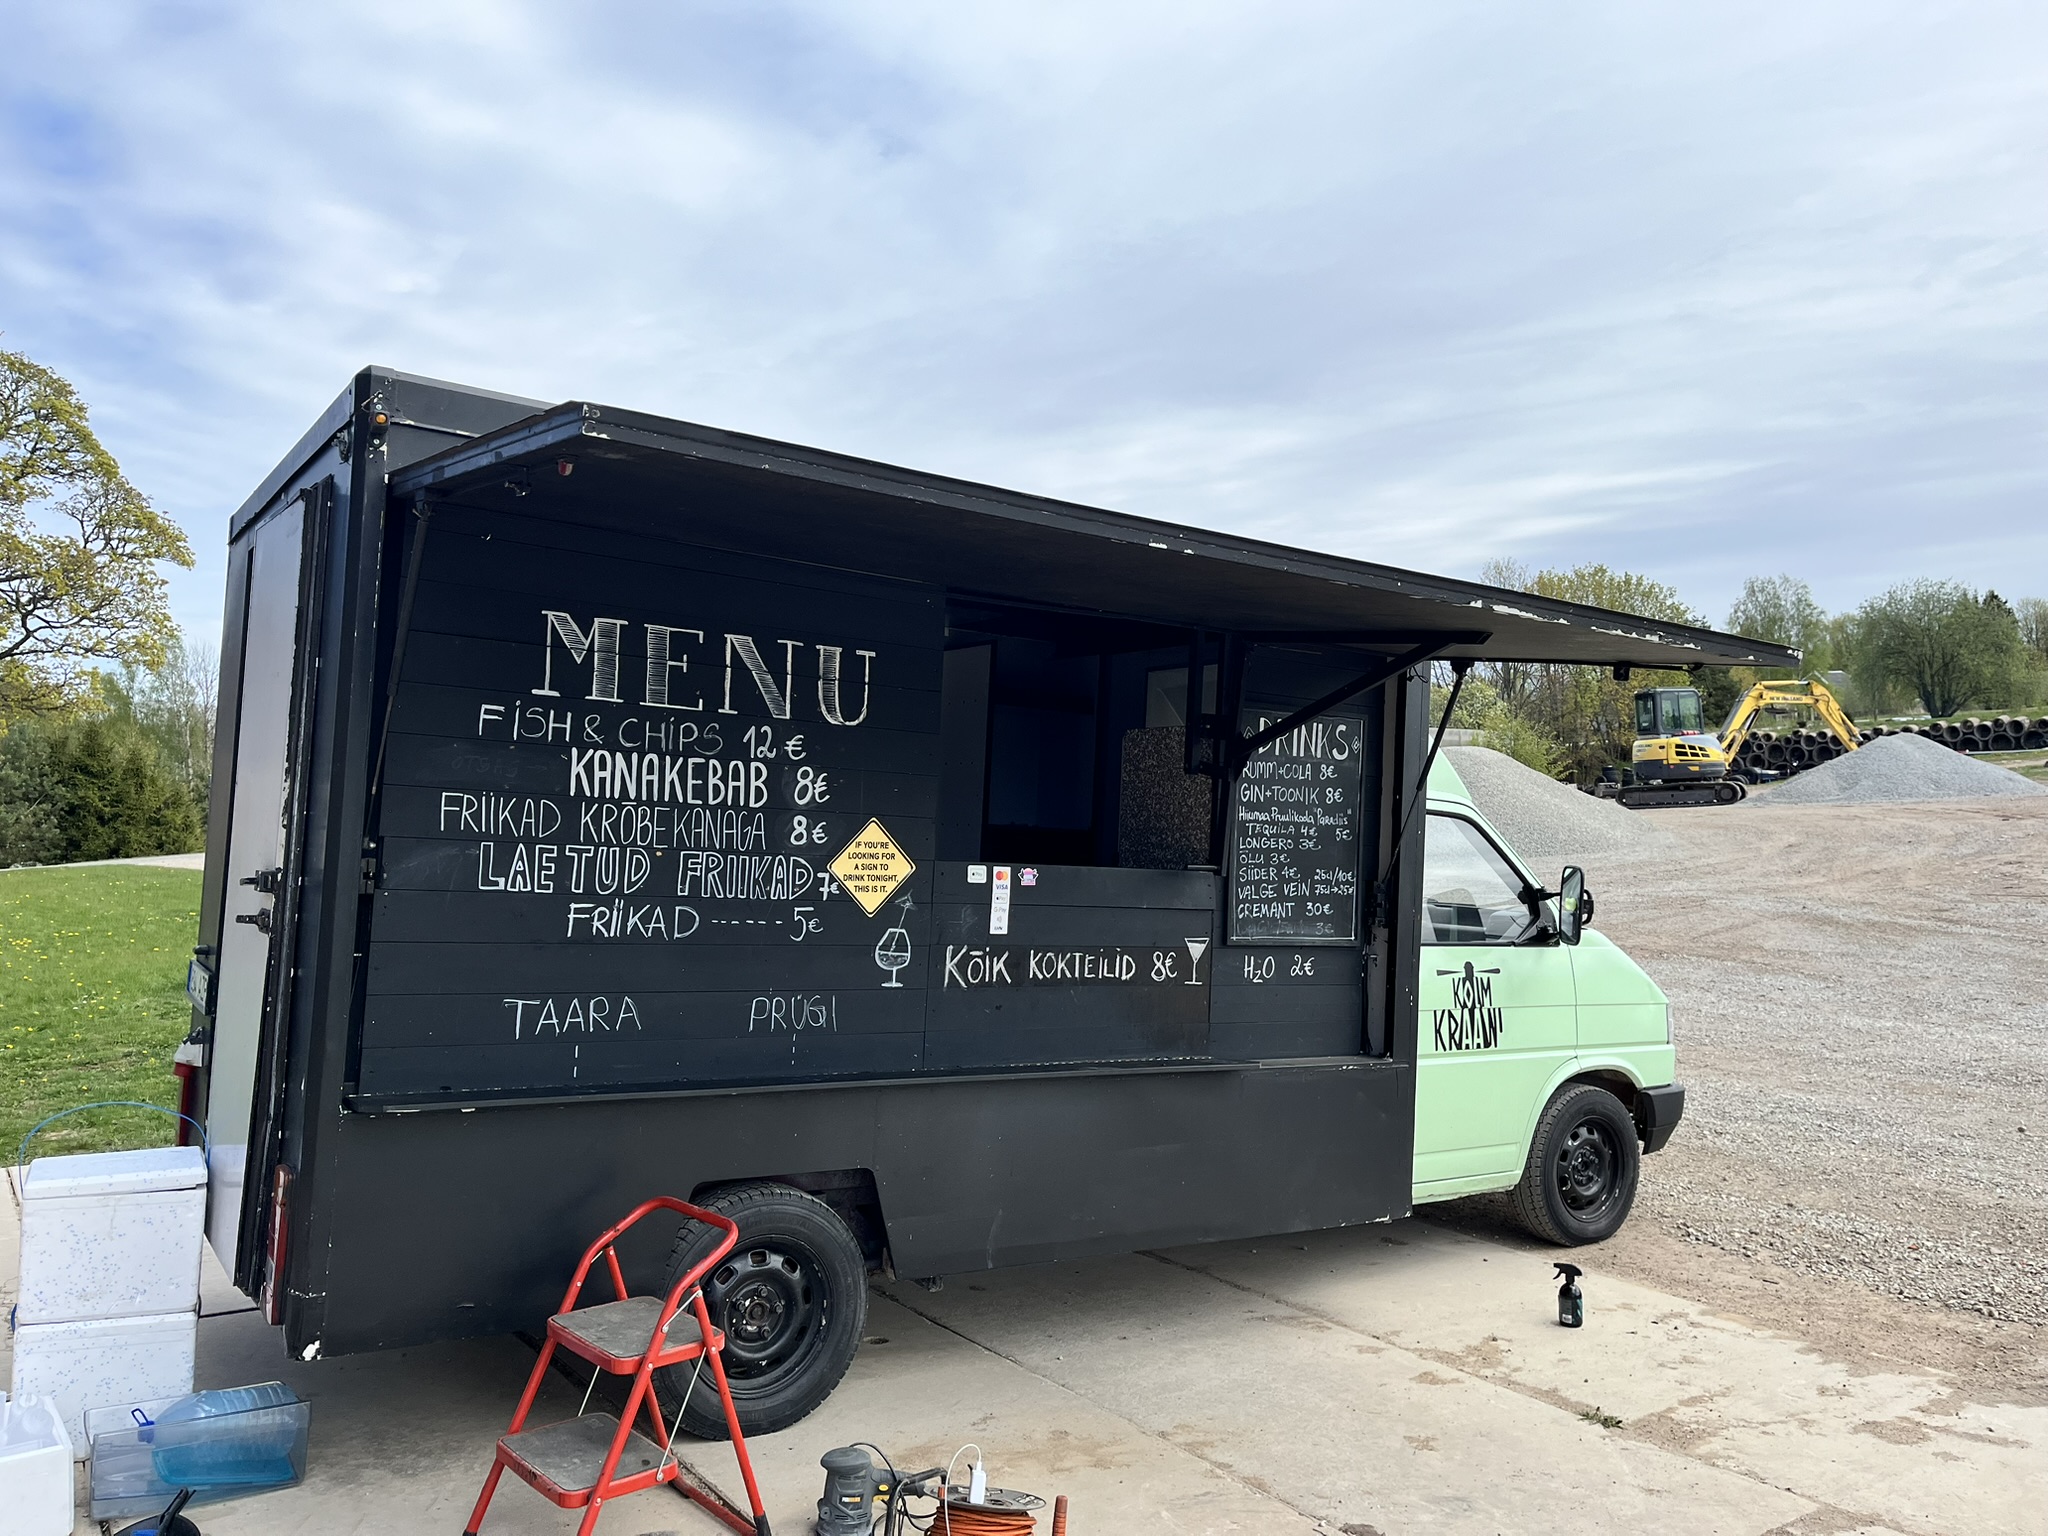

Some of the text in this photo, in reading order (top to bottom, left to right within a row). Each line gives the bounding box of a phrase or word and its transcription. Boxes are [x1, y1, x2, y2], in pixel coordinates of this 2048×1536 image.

[531, 610, 876, 726] MENU
[583, 714, 604, 744] &
[569, 747, 769, 808] KANAKEBAB
[794, 767, 831, 804] 8€
[1320, 764, 1337, 780] 8€
[1240, 783, 1343, 805] GIN+TOONIK 8€
[1301, 825, 1318, 837] 4€
[1335, 828, 1353, 841] 5€
[855, 841, 889, 849] IF YOU'RE
[1239, 837, 1321, 850] LONGERO 3€
[848, 852, 896, 860] LOOKING FOR
[1270, 853, 1290, 865] 3€
[478, 841, 840, 902] LAETUD FRIIKAD 7€
[854, 863, 889, 871] A SIGN TO
[843, 874, 865, 882] DRINK
[854, 885, 888, 893] THIS IS IT.
[1238, 884, 1278, 900] VALGE
[1283, 880, 1311, 897] VEIN
[1237, 901, 1333, 919] CREMANT 30€
[789, 906, 824, 942] 5€
[1150, 951, 1179, 982] 8€
[1290, 953, 1315, 978] 2€
[503, 996, 641, 1040] TAARA
